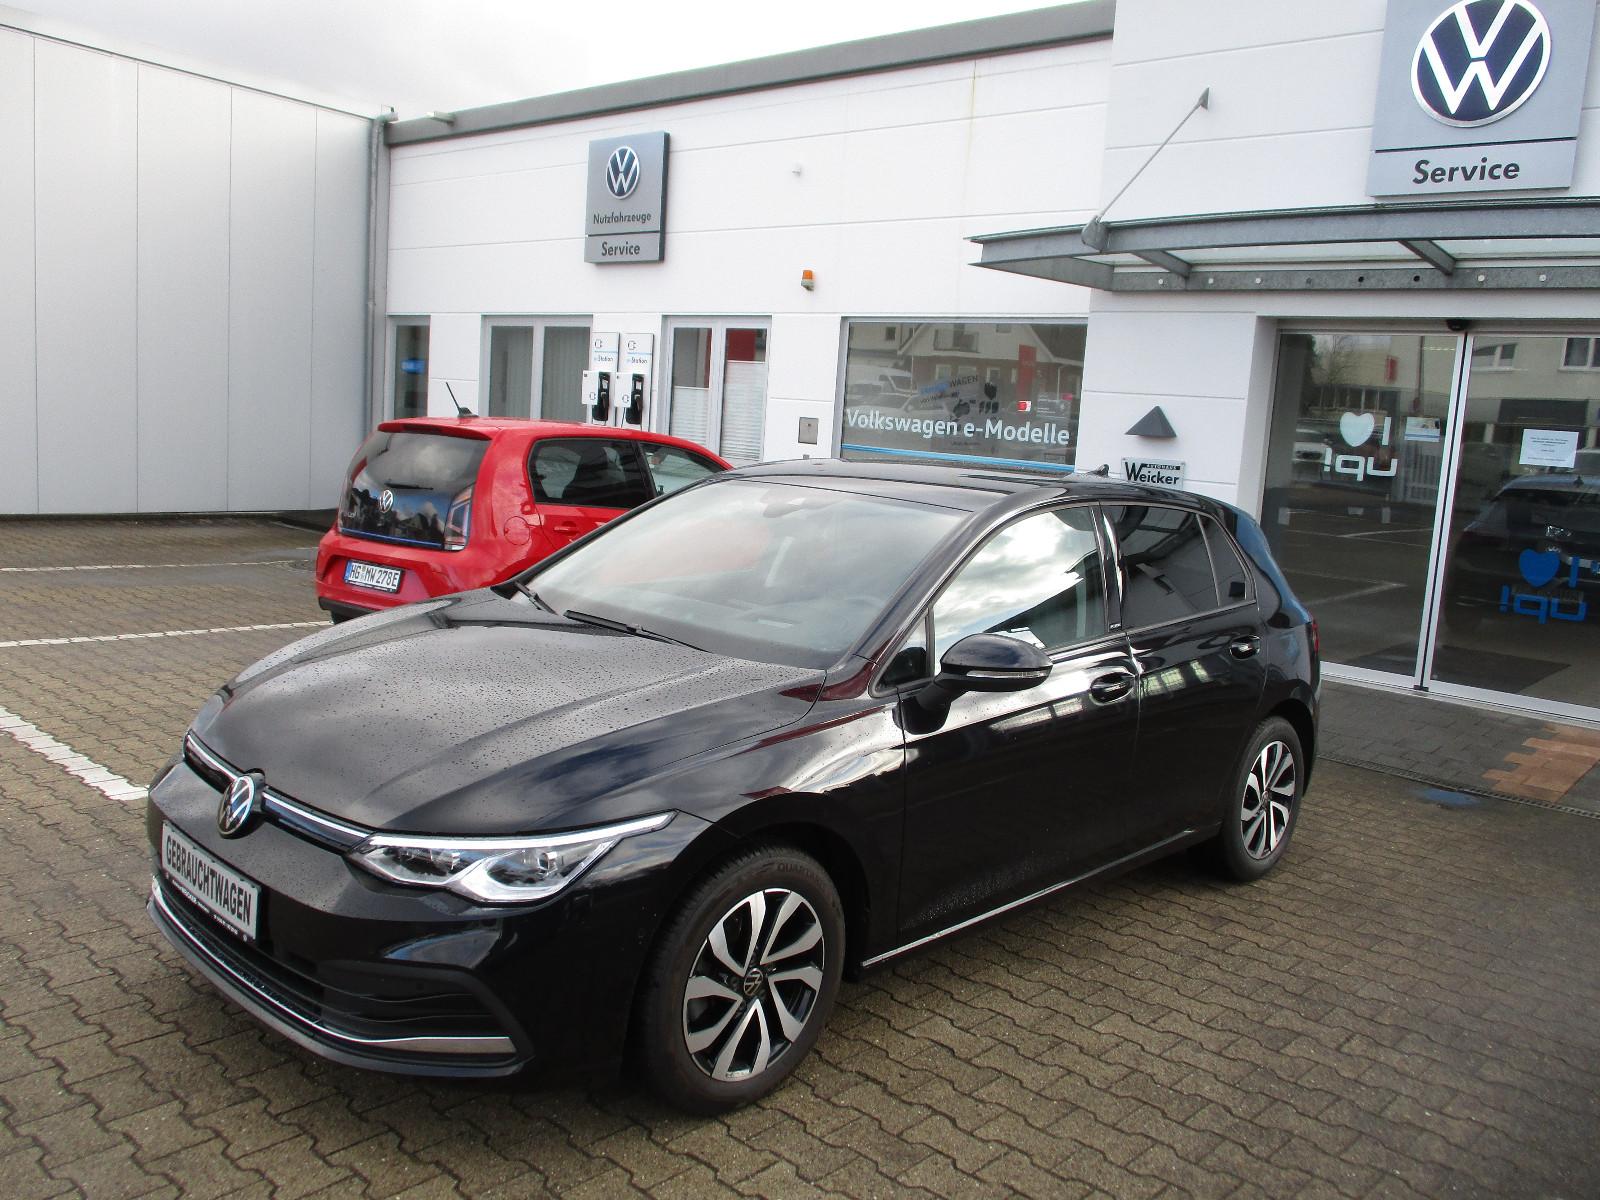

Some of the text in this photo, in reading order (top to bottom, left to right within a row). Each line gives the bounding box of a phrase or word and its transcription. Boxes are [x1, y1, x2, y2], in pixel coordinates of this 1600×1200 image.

[1413, 157, 1520, 184] Service
[593, 211, 652, 225] Nutzfahrzeuge
[601, 241, 641, 256] Service
[847, 409, 1070, 445] Volkswagen e-Modelle
[1125, 461, 1180, 484] Weicker
[376, 567, 399, 588] 278E
[166, 835, 252, 926] GEBRAUCHTWAGEN
